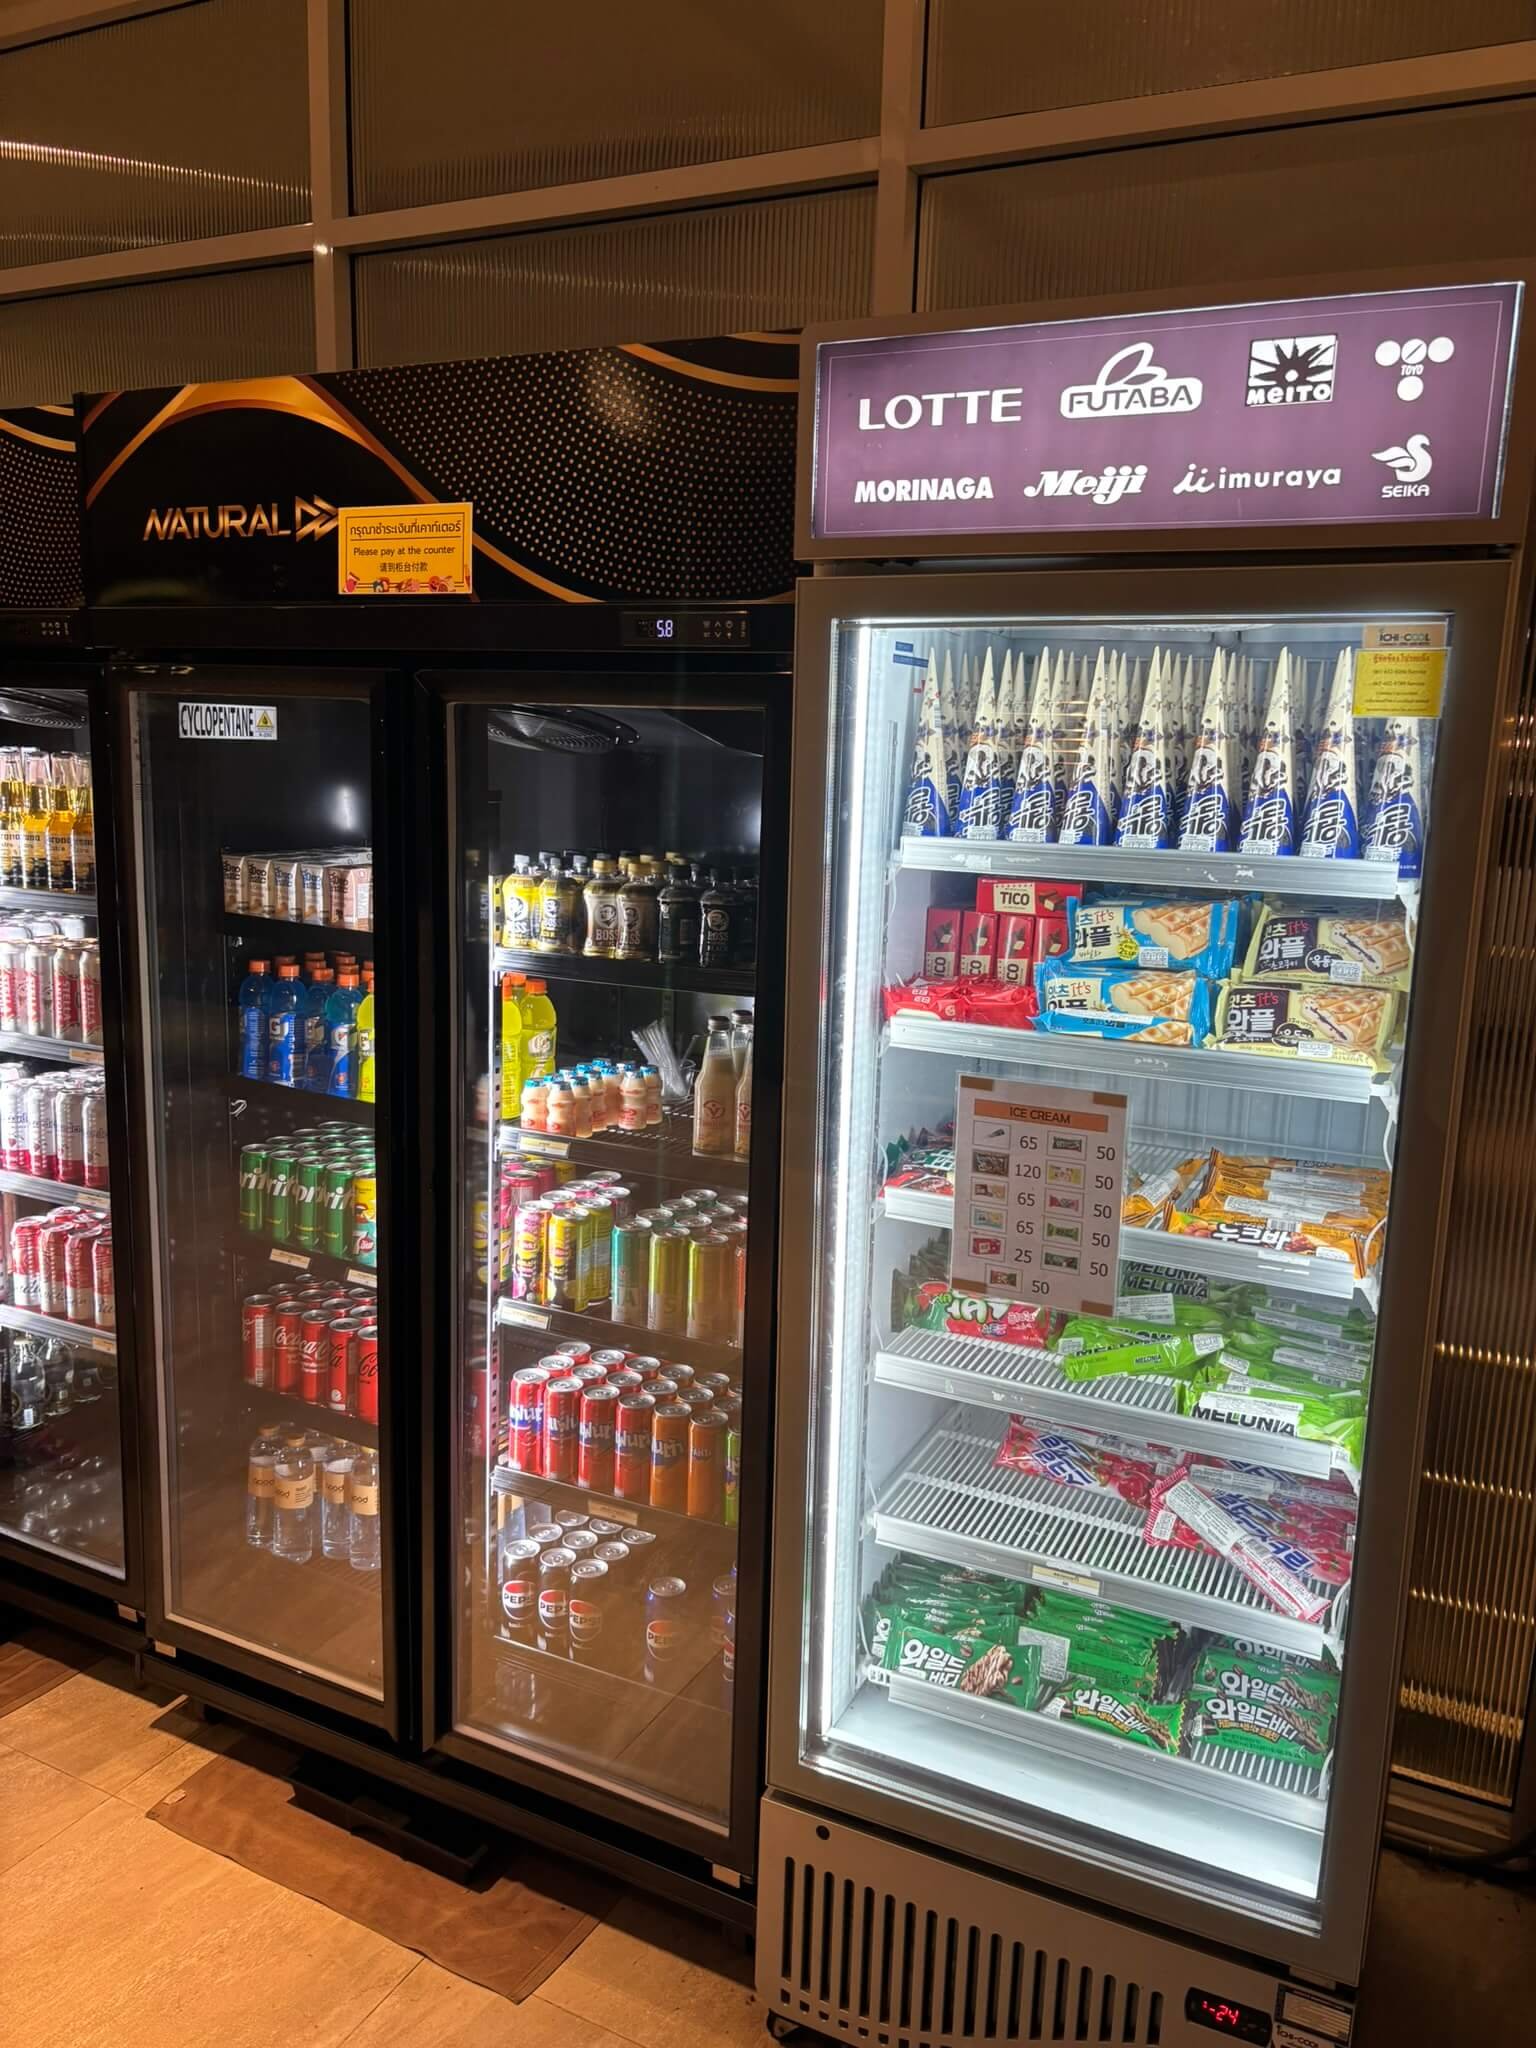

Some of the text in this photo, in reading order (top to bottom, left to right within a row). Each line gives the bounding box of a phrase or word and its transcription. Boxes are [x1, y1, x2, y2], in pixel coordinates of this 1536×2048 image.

[1068, 386, 1194, 413] FUTABA
[857, 388, 1023, 430] LOTTE
[1024, 465, 1150, 505] Meiji
[1219, 465, 1342, 490] imuraya
[854, 477, 994, 504] MORINAGA
[1382, 485, 1431, 498] SEIKA
[143, 503, 291, 541] NATURAL
[353, 546, 456, 557] Please pay at the counter
[379, 562, 429, 573] 请到柜台付款
[181, 704, 254, 737] CYCLOPENTANE
[1000, 891, 1030, 906] TICO
[1259, 936, 1305, 960] 와플
[934, 956, 946, 977] ICO
[1007, 963, 1020, 985] ICO
[1071, 981, 1091, 998] It's
[1226, 1008, 1275, 1031] 와플
[1009, 1106, 1071, 1125] ICE CREAM
[1019, 1135, 1038, 1150] 65
[1096, 1146, 1115, 1161] 50
[1016, 1164, 1041, 1180] 120
[1095, 1175, 1113, 1190] 50
[1017, 1192, 1036, 1207] 65
[1093, 1204, 1112, 1219] 50
[1016, 1220, 1034, 1235] 65
[1091, 1233, 1110, 1248] 50
[1014, 1248, 1033, 1264] 25
[1089, 1262, 1108, 1277] 50
[1032, 1280, 1050, 1295] 50
[504, 1593, 532, 1605] PEPS
[541, 1602, 567, 1615] PEPS
[1206, 1698, 1299, 1741] 와일드바디
